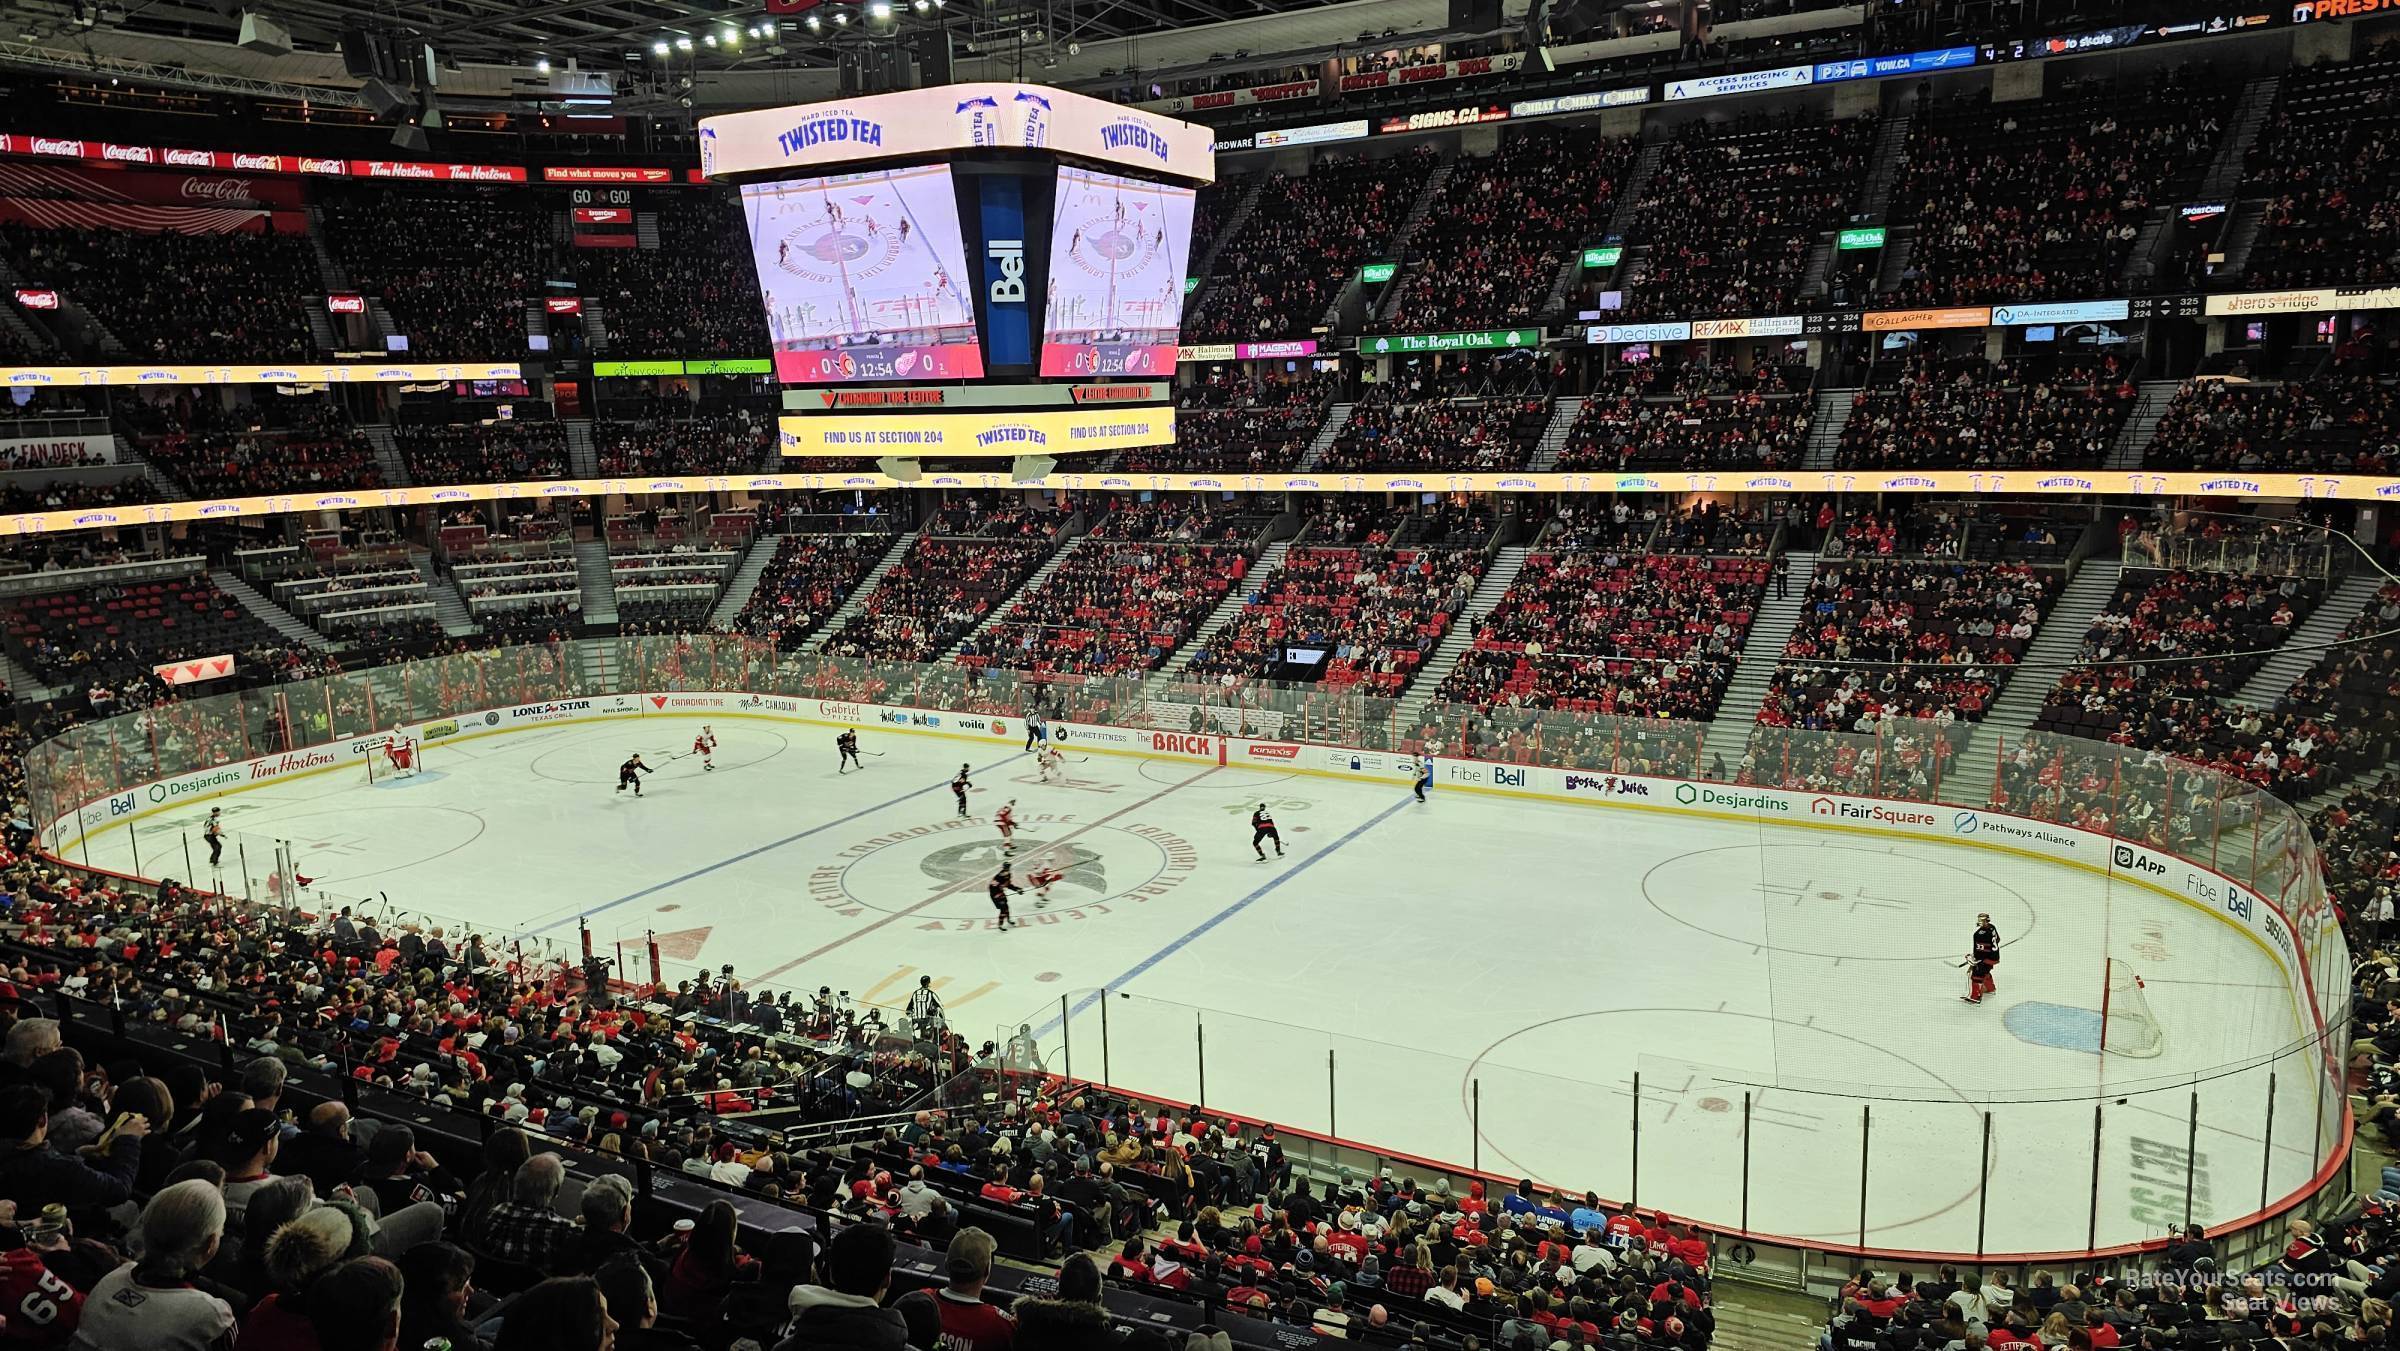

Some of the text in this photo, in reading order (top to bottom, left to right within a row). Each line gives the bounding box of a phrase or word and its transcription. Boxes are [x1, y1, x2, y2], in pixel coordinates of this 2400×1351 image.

[1985, 49, 1994, 60] 4
[2014, 46, 2023, 57] 2
[1503, 57, 1514, 67] 18
[1875, 58, 1911, 71] YOW.CA
[1193, 92, 1235, 110] BRIAN
[1342, 72, 1389, 91] SMITH
[1399, 63, 1447, 84] PRESS
[1458, 57, 1491, 76] BOX
[1698, 70, 1790, 87] ACCESS RIGGING
[1717, 80, 1769, 93] SERVICES
[1408, 107, 1480, 130] SIGNS.CA
[778, 119, 881, 158] TWISTED TEA
[1101, 123, 1168, 162] TWISTED TEA
[1213, 138, 1254, 151] ARDWARE
[369, 162, 434, 178] Tim Hortons
[448, 165, 512, 180] Tim Hortons
[547, 169, 637, 180] Find what moves you
[181, 176, 253, 200] Coca-Cola
[573, 189, 591, 204] GO
[610, 189, 631, 204] GO!
[989, 240, 1025, 303] Bell
[2134, 299, 2152, 308] 324
[2179, 297, 2199, 305] 325
[1843, 313, 1859, 321] 324
[2017, 308, 2079, 318] DA-INTEGRATED
[2133, 309, 2152, 317] 224
[2179, 307, 2198, 315] 225
[1807, 315, 1823, 323] 323
[1875, 313, 1934, 327] GALLAGHER
[1611, 326, 1683, 342] Decisive
[1695, 318, 1801, 336] RE/MAX Hallmark
[1259, 343, 1304, 353] MAGENTA
[1400, 333, 1493, 350] The Royal Oak
[1198, 345, 1234, 354] Hallmark
[821, 358, 831, 374] 0
[923, 355, 933, 371] 0
[1075, 352, 1082, 369] 0
[1101, 358, 1124, 373] 12:54
[1143, 353, 1149, 369] 0
[138, 372, 178, 382] TWISTED TEA
[259, 370, 298, 379] TWISTED TEA
[861, 362, 894, 377] 12:54
[8, 372, 52, 383] TWISTED TEA
[838, 392, 885, 406] CANADIAN
[824, 430, 943, 443] FIND US AT SECTION 204
[976, 428, 1046, 447] TWISTED TEA
[1071, 423, 1149, 439] FIND US AT SECTION 204
[21, 444, 48, 462] FAN
[52, 442, 87, 462] DECK
[649, 482, 673, 491] TWISTED
[843, 478, 865, 486] TWISTED
[1189, 479, 1222, 489] TWISTED TEA
[1386, 479, 1423, 489] TWISTED TEA
[1616, 479, 1659, 489] TWISTED TEA
[1884, 477, 1936, 488] TWISTED TEA
[2037, 477, 2092, 490] TWISTED TEA
[2200, 480, 2259, 493] TWISTED TEA
[432, 491, 470, 500] TWISTED TEA
[198, 504, 240, 515] TWISTED TEA
[73, 514, 118, 527] TWISTED TEA
[512, 700, 591, 718] LONE STAR
[671, 698, 724, 707] CANADIAN TIRE
[765, 699, 798, 712] CANADIAN
[819, 701, 861, 718] Gabriel
[531, 712, 573, 722] TEXAS GRILL
[1070, 730, 1127, 742] PLANET FITNESS
[1136, 731, 1211, 756] The BRICK
[248, 752, 336, 781] Tim Hortons
[1451, 765, 1481, 781] Fibe
[170, 771, 240, 796] Desjardins
[1494, 767, 1525, 786] Bell
[1565, 775, 1649, 796] Booster Juice
[110, 792, 136, 816] Bell
[1702, 789, 1789, 811] Desjardins
[1840, 803, 1935, 826] FairSquare
[836, 817, 987, 859] CANADIAN
[1983, 822, 2076, 848] Pathways Alliance
[1122, 823, 1199, 902] CANADIAN TIRE
[808, 865, 855, 909] CENTRE
[2187, 873, 2217, 902] Fibe
[2227, 886, 2253, 923] Bell
